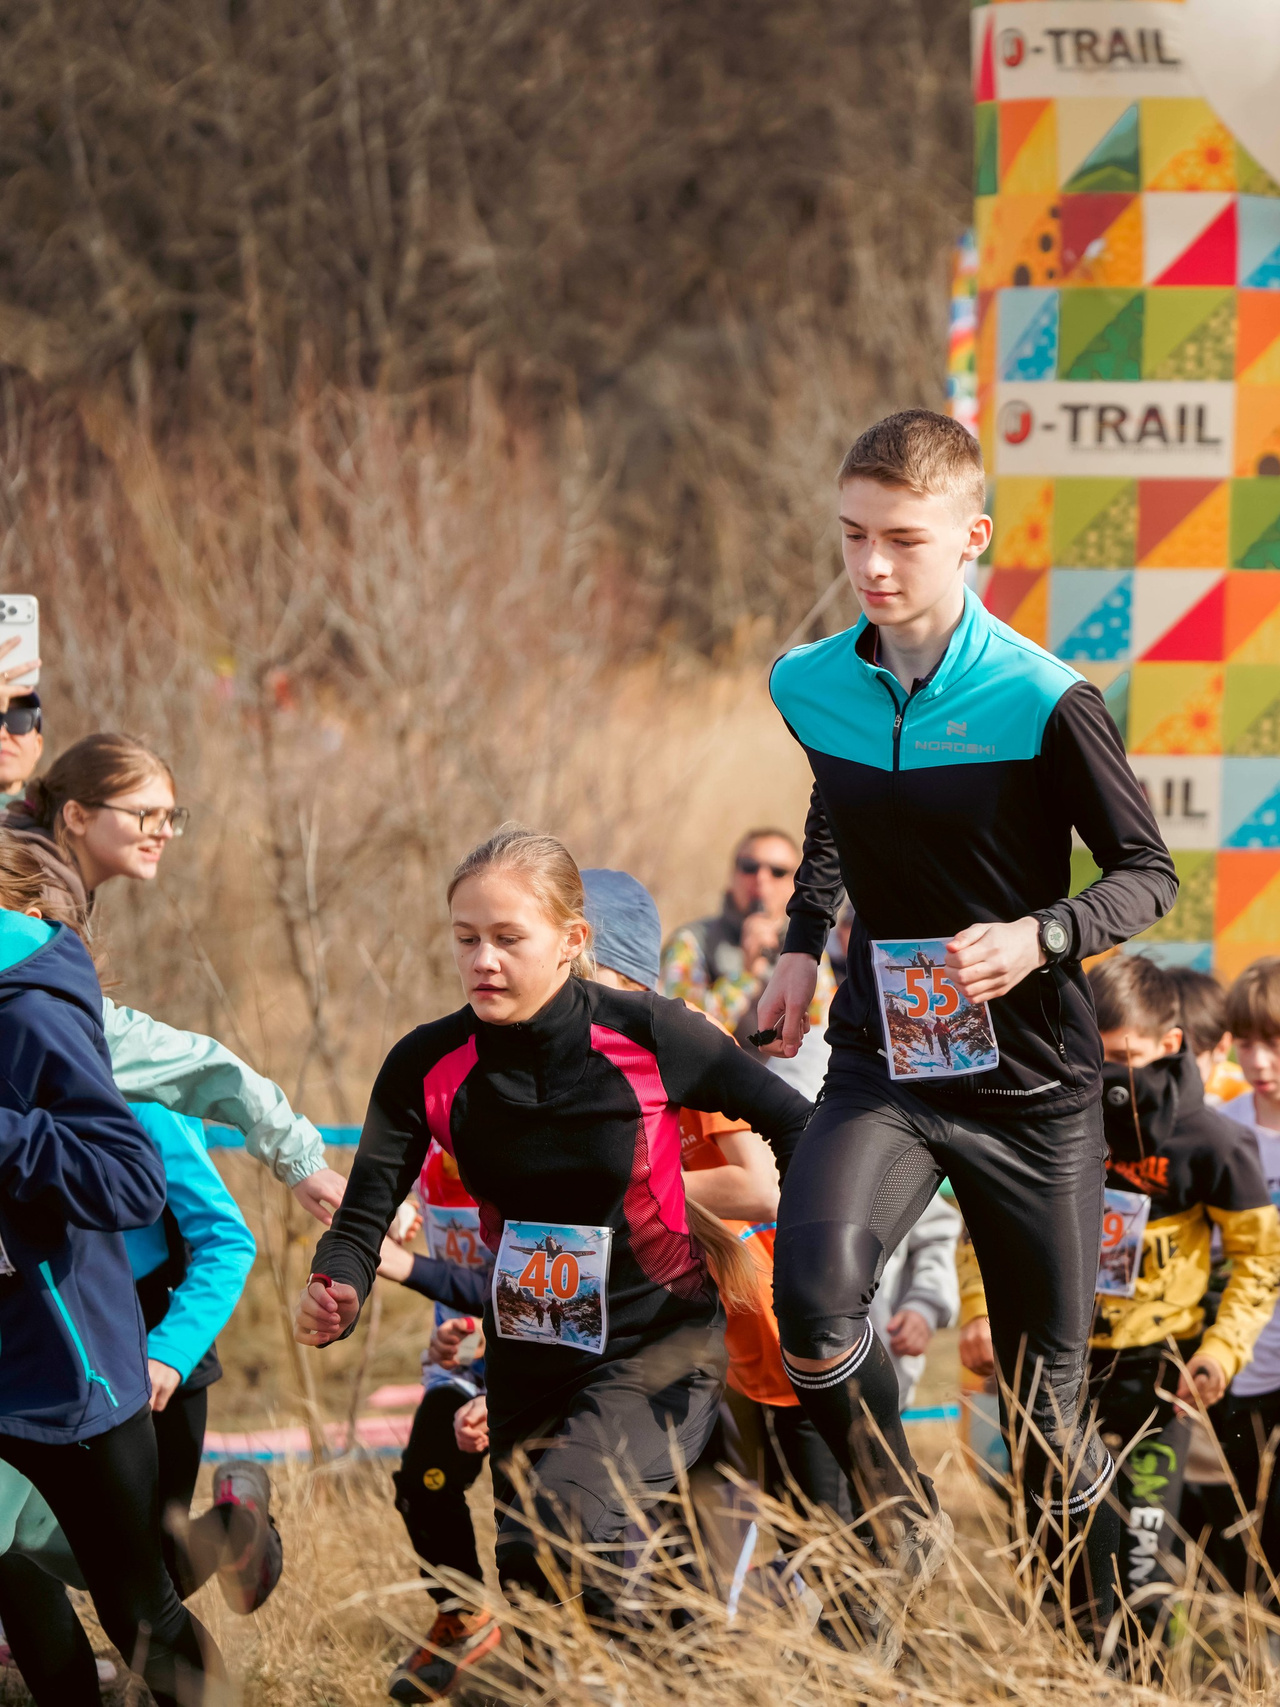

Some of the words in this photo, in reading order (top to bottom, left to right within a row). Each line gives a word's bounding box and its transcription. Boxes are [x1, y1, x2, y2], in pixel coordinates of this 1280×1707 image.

[914, 740, 996, 756] NORDSKI
[905, 967, 960, 1018] 55
[445, 1228, 484, 1265] 42
[518, 1250, 580, 1300] 40
